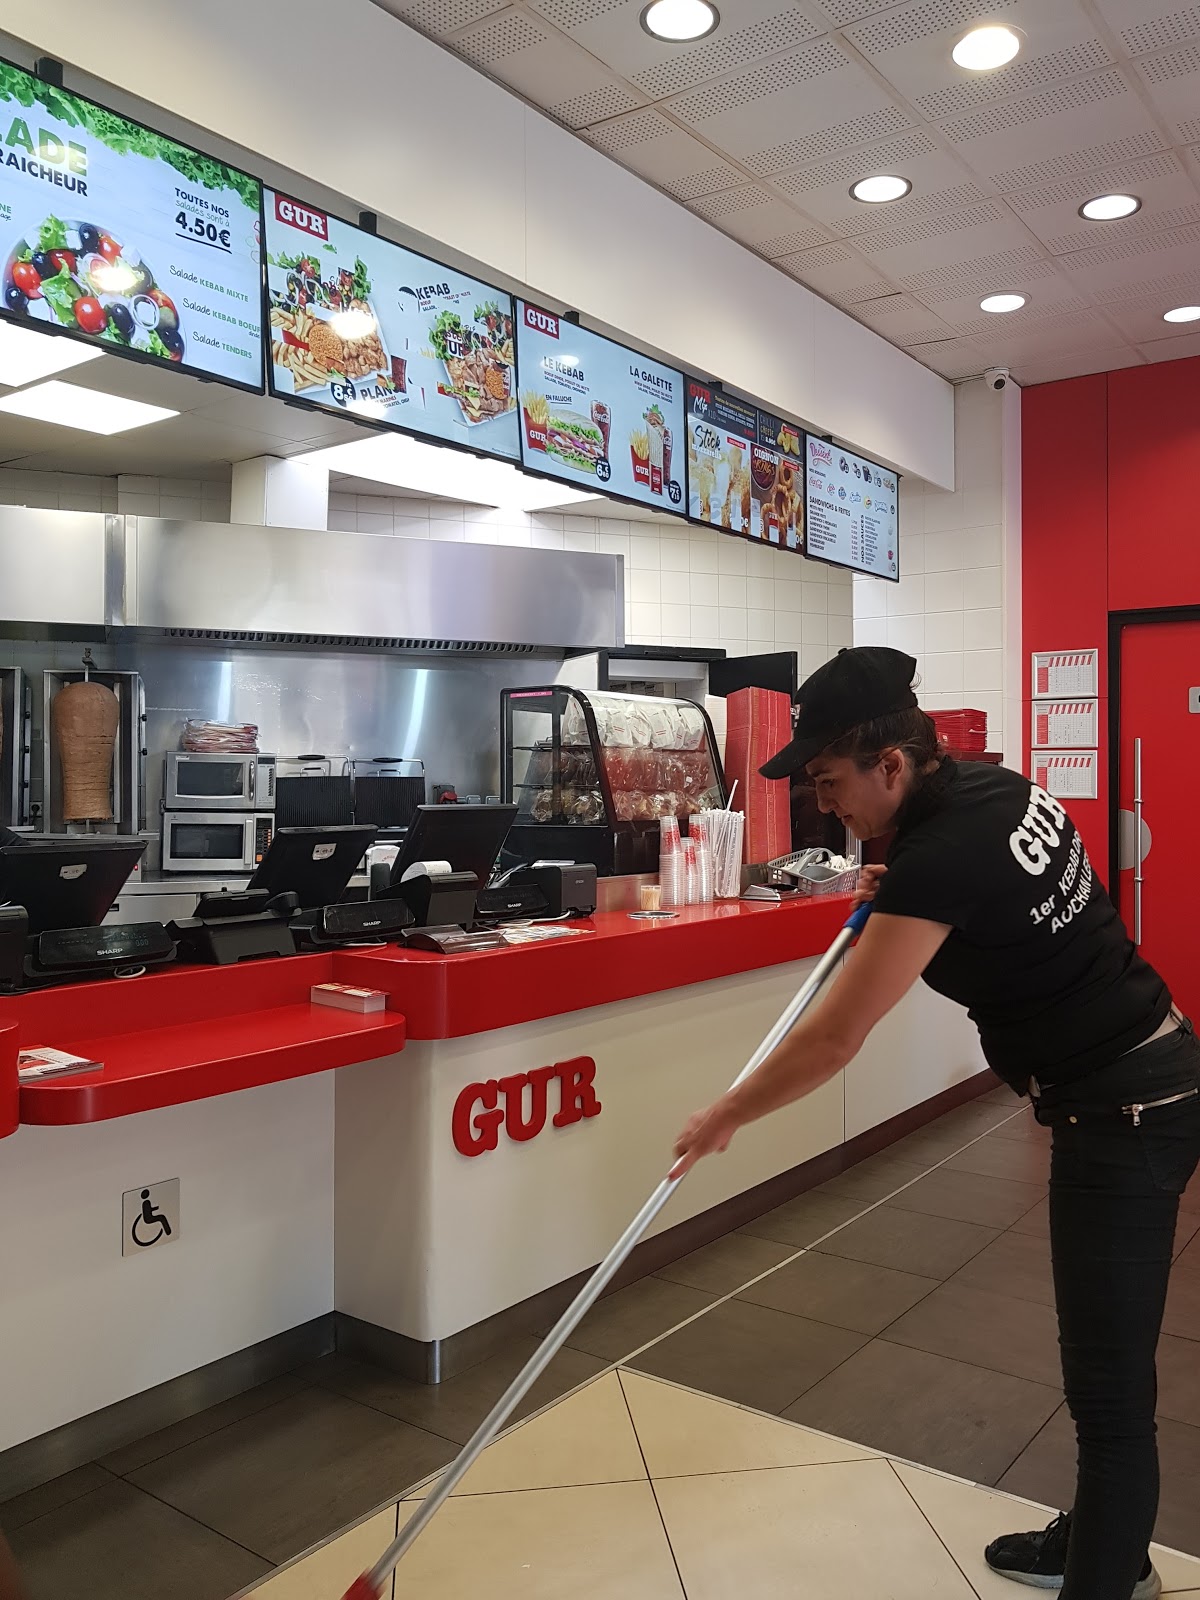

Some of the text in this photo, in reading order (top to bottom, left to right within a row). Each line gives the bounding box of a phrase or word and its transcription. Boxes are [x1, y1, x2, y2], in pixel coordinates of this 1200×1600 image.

[0, 117, 87, 177] ADE
[175, 187, 230, 218] TOUTES NOS
[175, 200, 205, 216] salades
[206, 212, 224, 225] sont
[278, 200, 326, 235] GUR
[175, 211, 231, 248] 4.50€
[169, 264, 249, 303] Salade KEBAB MIXTE
[182, 297, 260, 332] Salade KEBAB BOEUF
[526, 308, 557, 335] GUR
[192, 331, 252, 359] Salade TENDERS
[543, 355, 584, 382] LE KEBAB
[629, 365, 673, 393] LA GALETTE
[1009, 784, 1067, 876] GUR
[1030, 894, 1056, 925] 1er
[1058, 848, 1080, 896] KEBAB
[1051, 874, 1092, 934] AUCHAN
[96, 948, 123, 956] SHARP
[452, 1055, 602, 1157] GUR
